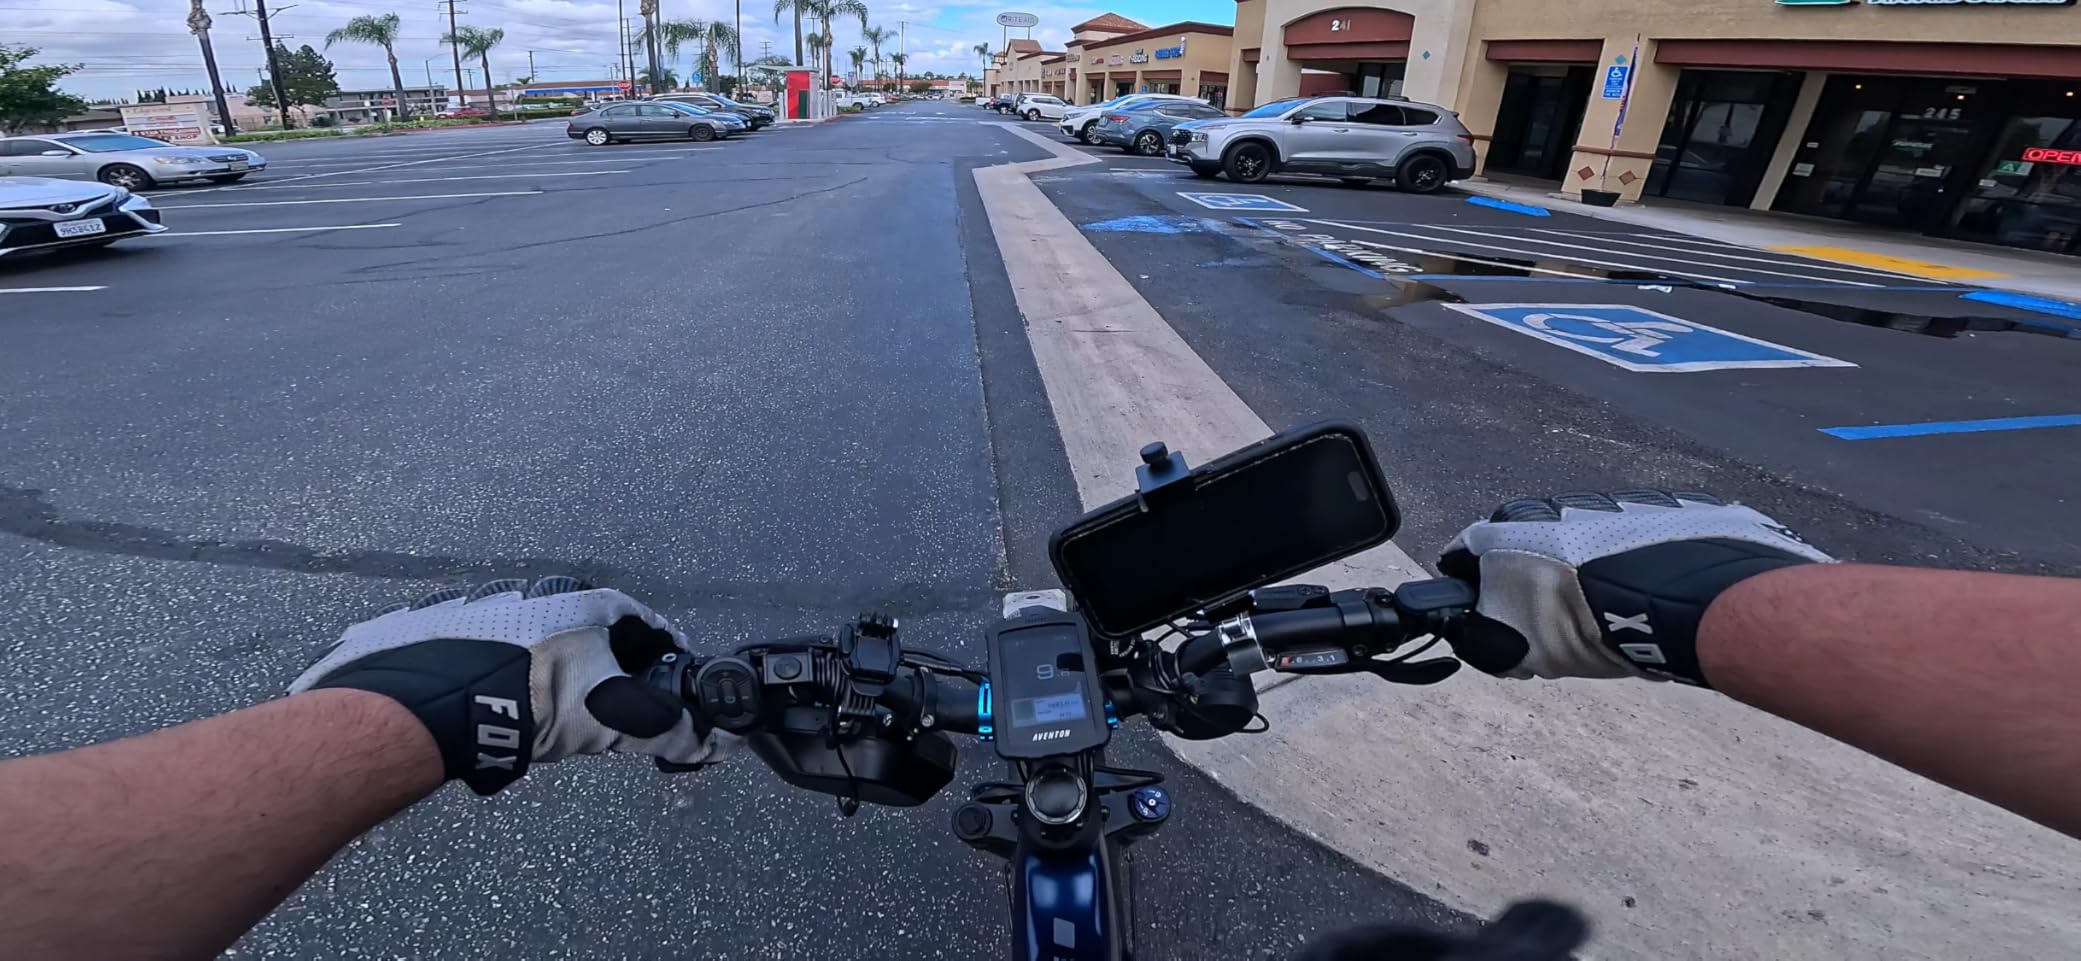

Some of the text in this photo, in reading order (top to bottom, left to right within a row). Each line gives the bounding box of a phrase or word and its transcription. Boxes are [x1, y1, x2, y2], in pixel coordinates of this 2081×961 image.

[1604, 611, 1672, 676] OX
[475, 695, 520, 771] FOX
[1032, 729, 1071, 741] AVENTON
